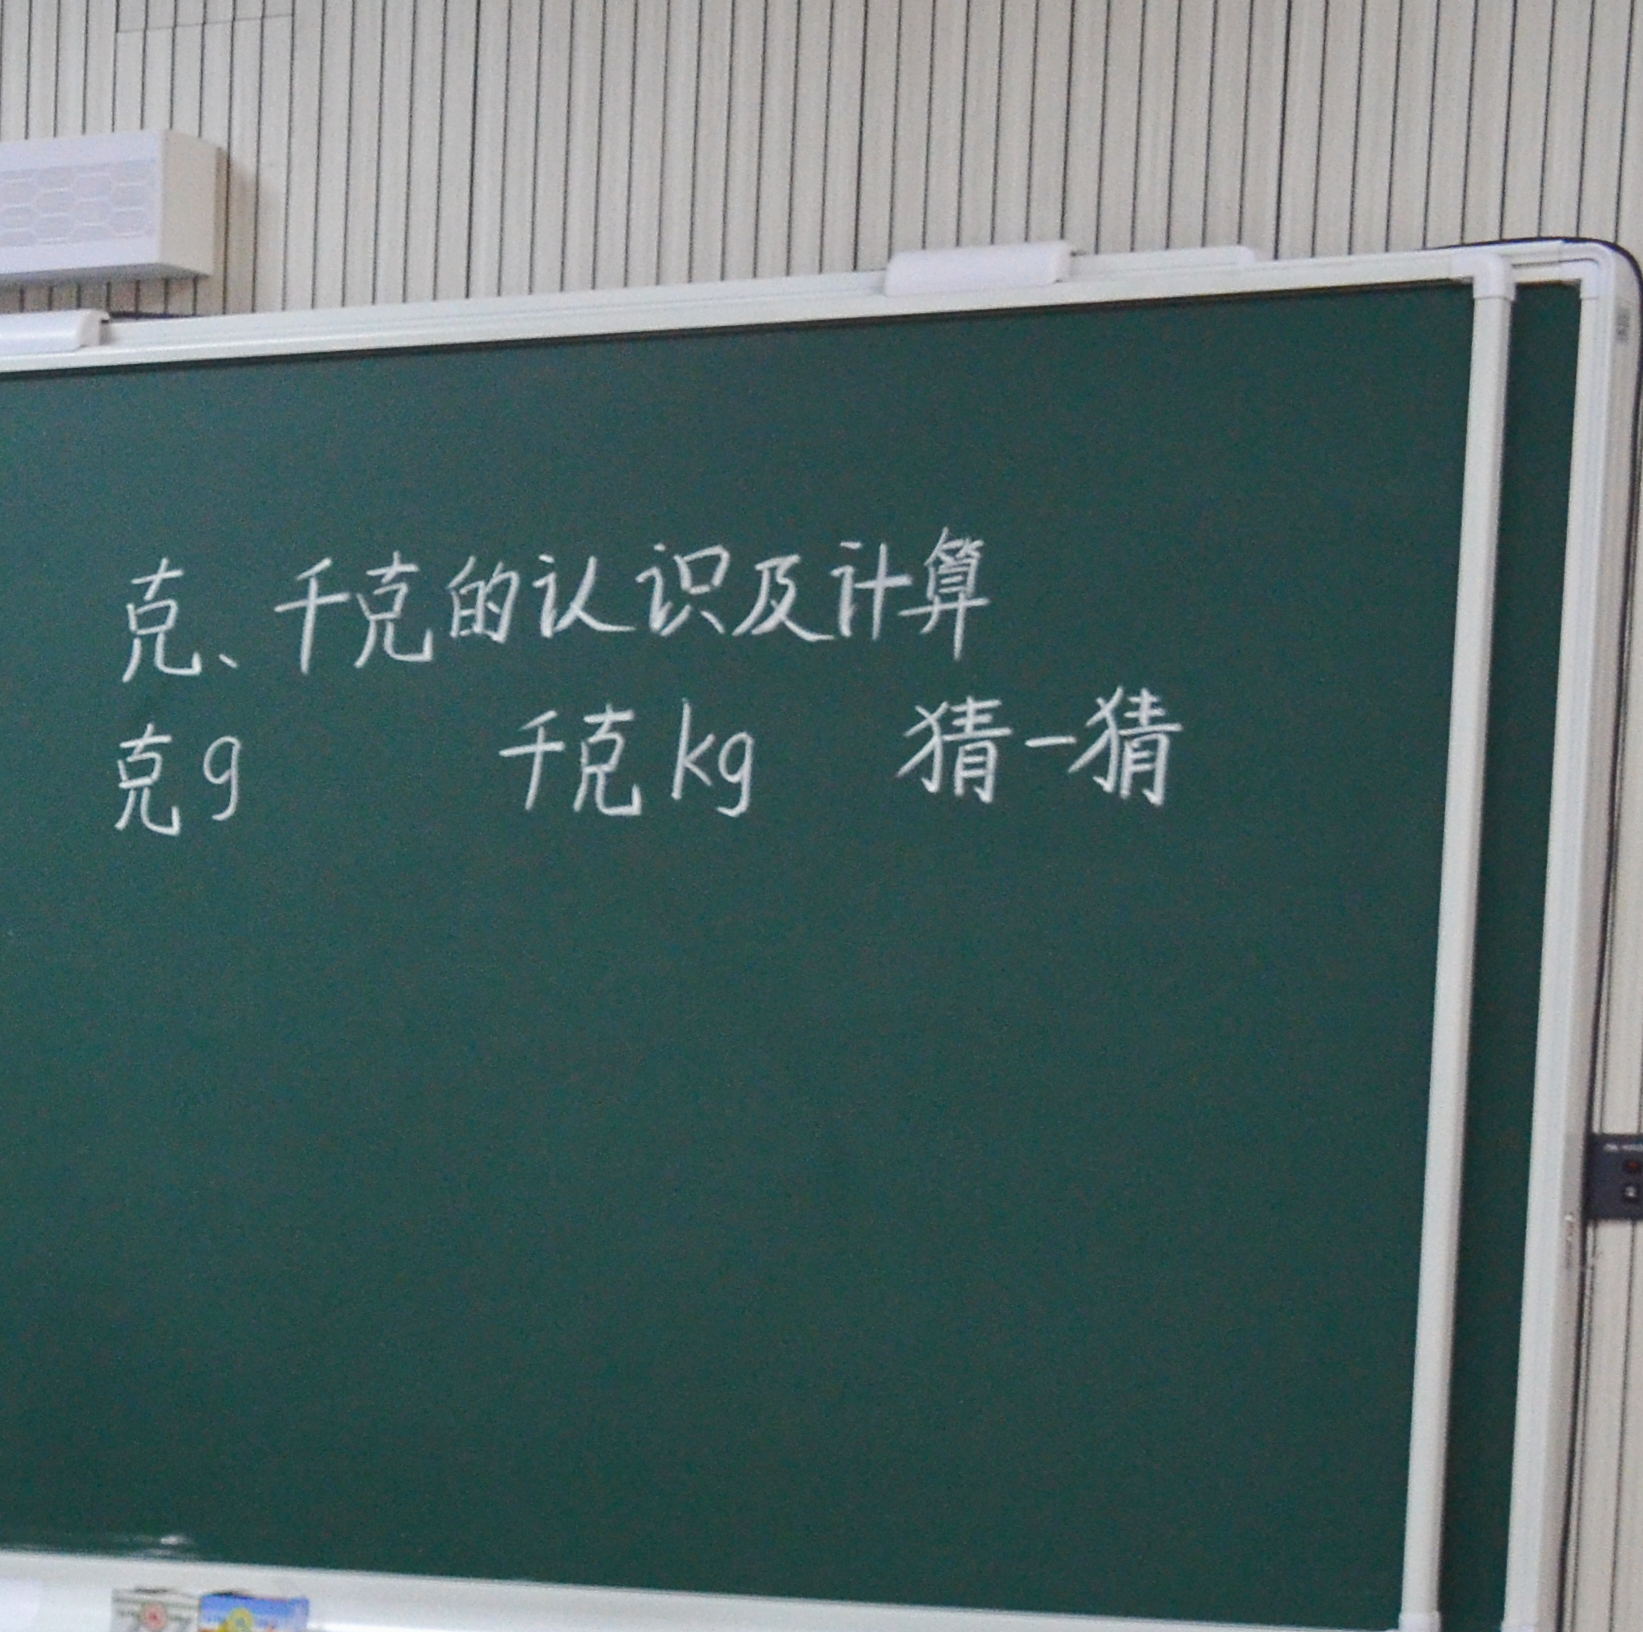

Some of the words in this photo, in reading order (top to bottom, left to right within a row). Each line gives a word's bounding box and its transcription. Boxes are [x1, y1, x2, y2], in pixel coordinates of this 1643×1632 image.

[121, 526, 990, 684] 克、千克的认识及计算
